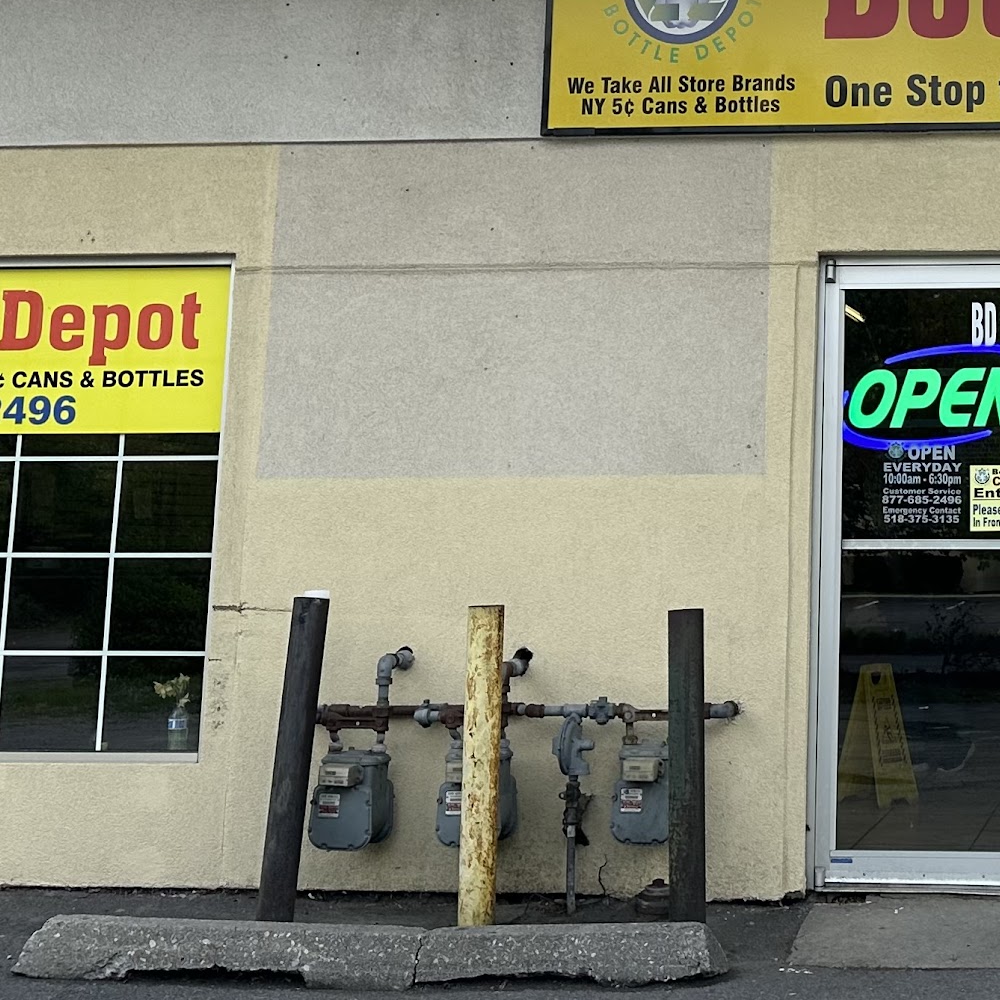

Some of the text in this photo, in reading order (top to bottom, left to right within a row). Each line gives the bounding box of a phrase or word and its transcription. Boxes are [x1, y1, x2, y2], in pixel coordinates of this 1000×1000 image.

[603, 3, 680, 63] BOTTLE
[568, 74, 795, 94] We Take All Store Brands
[825, 75, 892, 108] One
[906, 73, 985, 112] Stop
[581, 96, 781, 117] NY 5¢ Cans & Bottles
[0, 290, 201, 366] Depot
[971, 302, 996, 346] BD
[12, 371, 73, 388] CANS
[80, 371, 94, 388] &
[103, 370, 204, 387] BOTTLES
[0, 395, 76, 425] 496
[907, 445, 956, 460] OPEN
[883, 463, 962, 472] EVERYDAY
[883, 473, 921, 484] 10:00am
[929, 473, 961, 486] 6:30pm
[882, 496, 962, 504] 877-685-2496
[883, 507, 927, 516] Emergency
[884, 515, 959, 523] 518-375-3135
[973, 518, 980, 527] In
